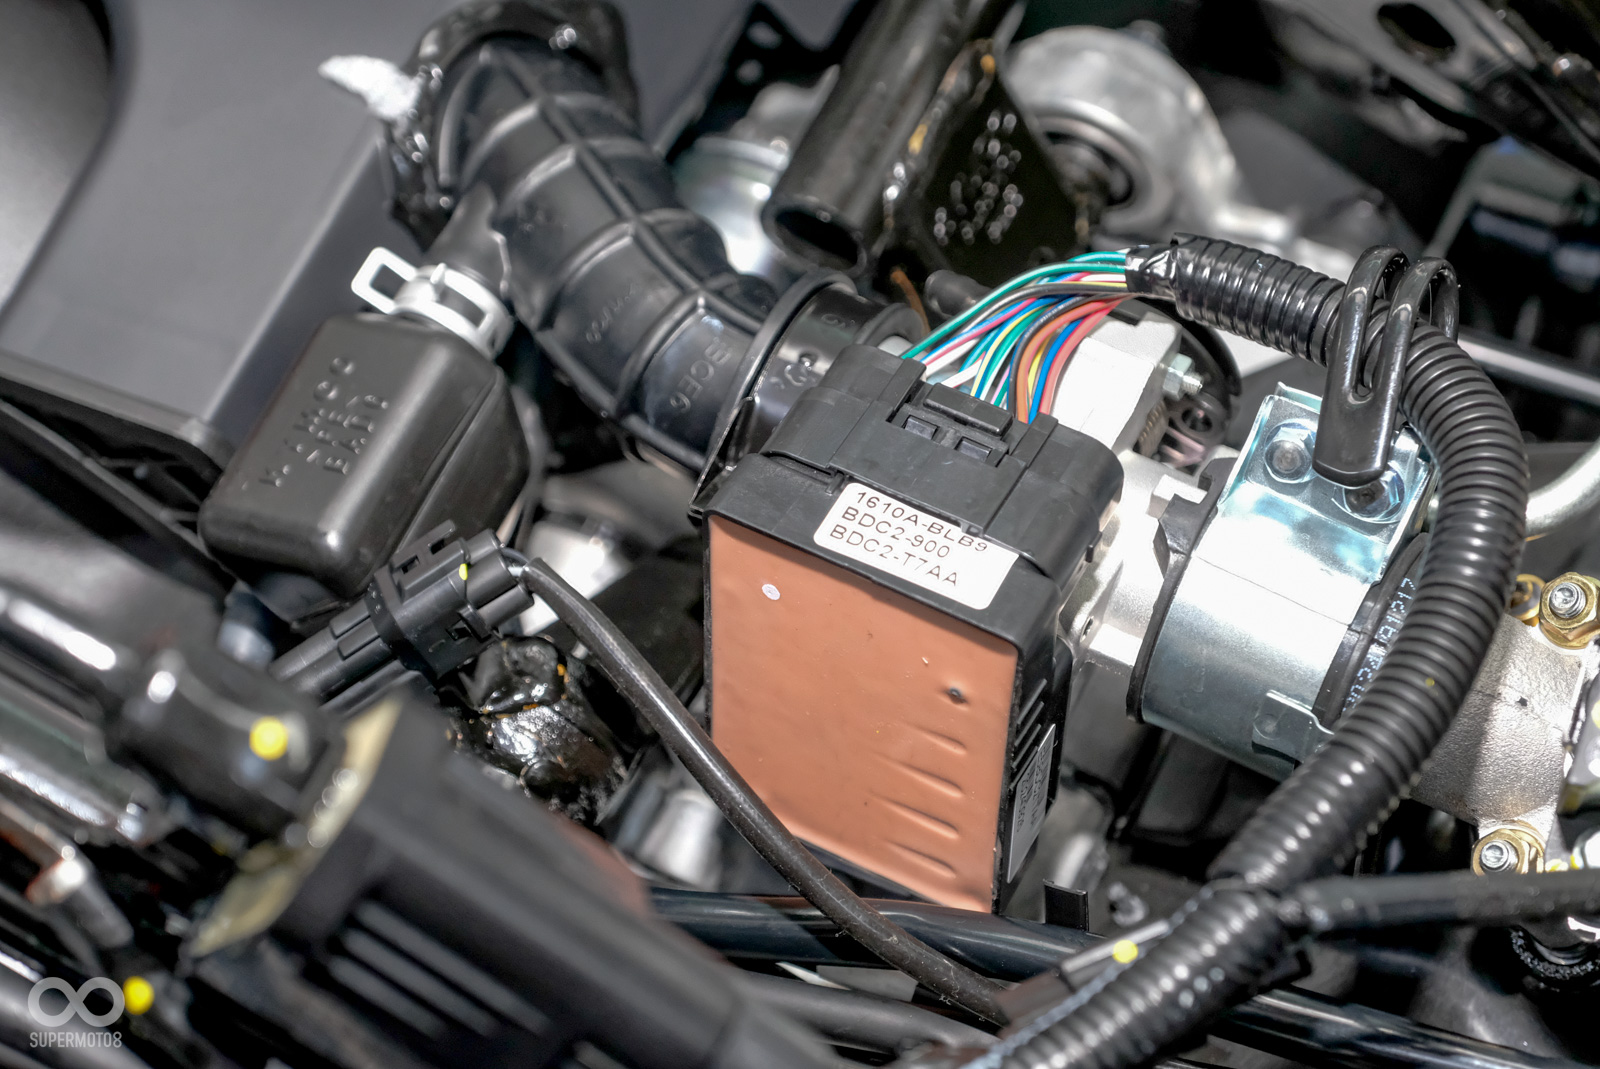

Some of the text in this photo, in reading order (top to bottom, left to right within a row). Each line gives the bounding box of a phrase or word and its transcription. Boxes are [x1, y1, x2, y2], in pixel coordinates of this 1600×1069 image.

[841, 505, 950, 558] BDC2-900
[856, 491, 989, 552] 1610A-BLB9
[829, 524, 959, 587] BDC2-T7AA
